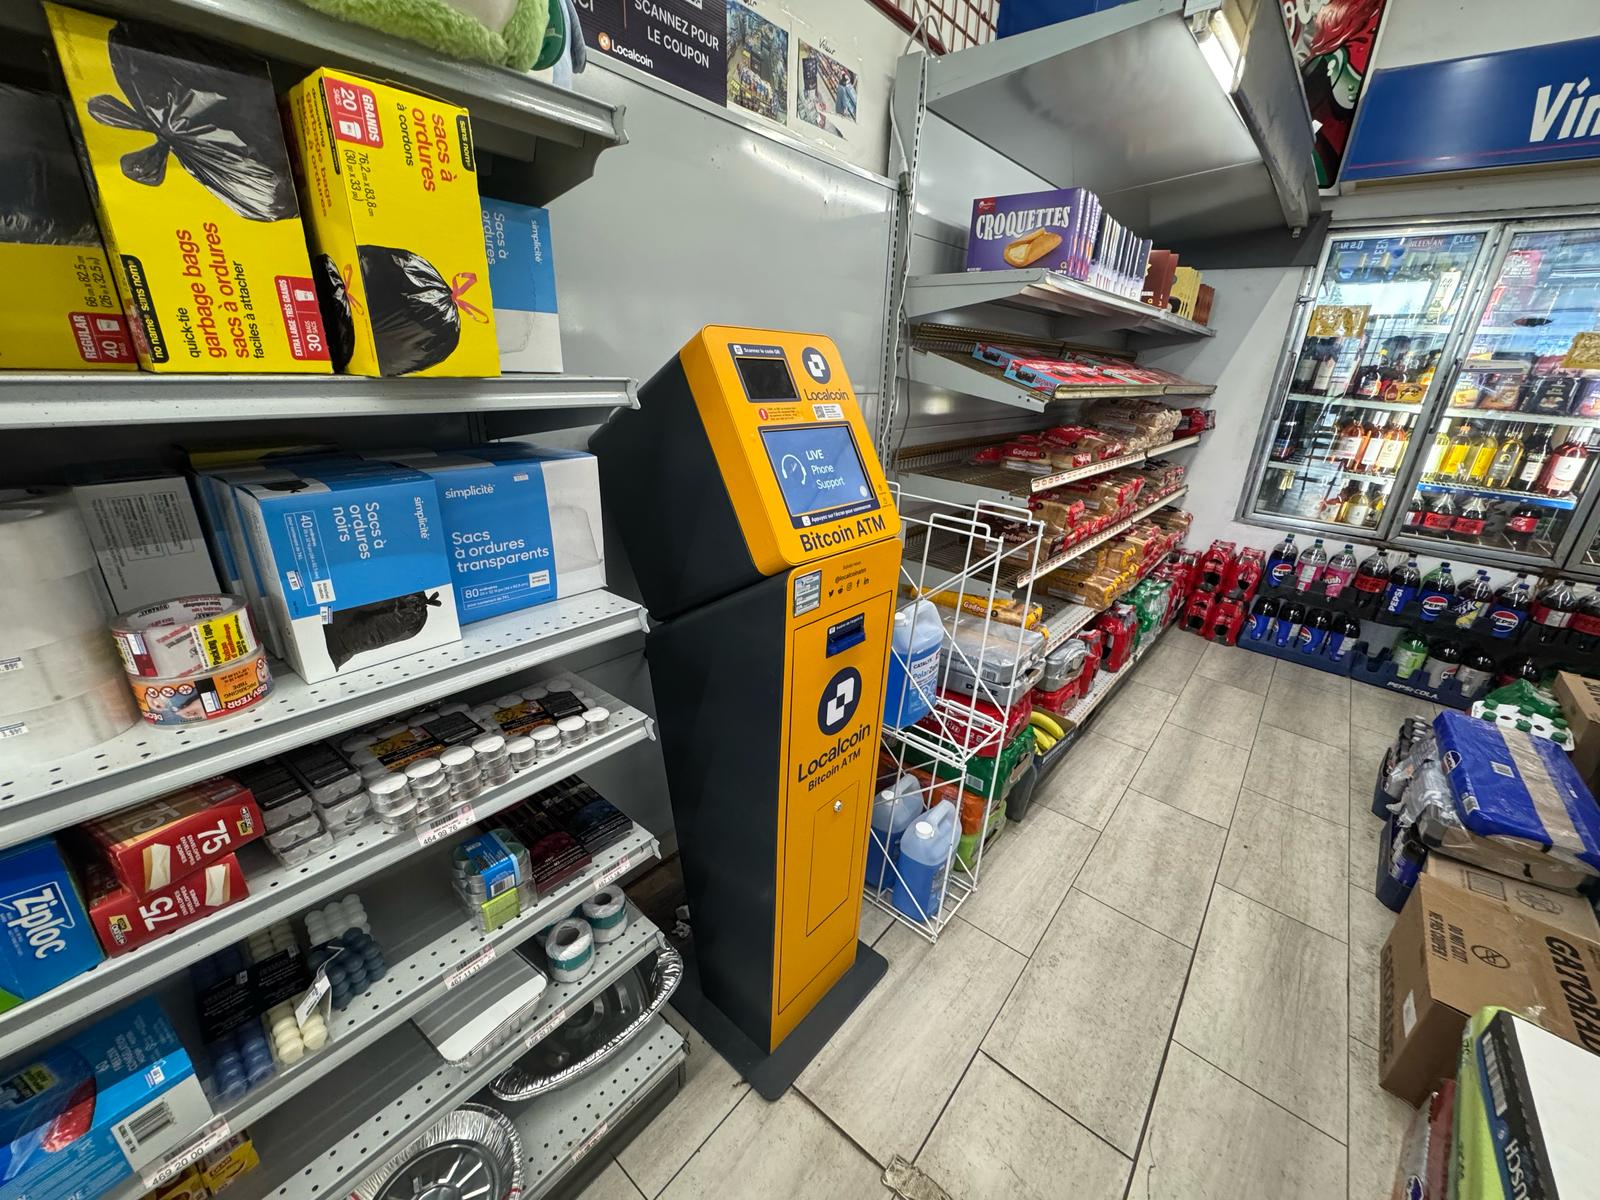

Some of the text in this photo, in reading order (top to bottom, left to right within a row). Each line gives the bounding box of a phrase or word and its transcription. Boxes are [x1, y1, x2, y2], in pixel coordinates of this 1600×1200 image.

[634, 0, 719, 52] SCANNEZ POUR
[611, 38, 654, 69] Localcoin
[647, 26, 709, 69] LE COUPON
[333, 88, 343, 106] SACS
[340, 87, 358, 112] 20
[305, 91, 323, 163] garbage
[362, 93, 381, 143] GRANDS
[396, 102, 414, 166] à cordons
[411, 107, 436, 192] ordures
[431, 112, 457, 182] sacs à
[482, 209, 496, 265] ordures
[494, 211, 510, 260] Sacs à
[975, 205, 1073, 241] CROQUETTES
[137, 288, 150, 311] sans
[176, 229, 228, 359] garbage bags
[203, 222, 249, 359] sacs à ordures
[233, 260, 253, 311] attacher
[72, 315, 98, 360] REGULAR
[102, 340, 119, 358] 40
[177, 307, 201, 359] quick-tie
[249, 323, 264, 359] faciles
[306, 334, 322, 352] 30
[803, 388, 850, 402] Localcoin
[805, 449, 825, 461] LIVE
[810, 464, 835, 475] Phone
[444, 483, 496, 501] simplicité
[815, 476, 846, 491] Support
[300, 514, 314, 529] 40
[331, 506, 351, 544] noirs
[348, 504, 371, 560] ordures
[363, 501, 385, 550] Sacs à
[412, 495, 430, 540] simplicité
[799, 514, 887, 553] Bitcoin ATM
[450, 529, 491, 547] Sacs
[453, 539, 526, 560] à ordures
[455, 546, 550, 575] transparents
[465, 588, 480, 599] 80
[1388, 588, 1404, 613] PEPSI
[1492, 616, 1519, 629] PEPSI
[227, 693, 253, 709] TEAR
[796, 722, 872, 783] Localcoin
[807, 749, 862, 793] Bitcoin ATM
[179, 836, 196, 866] ENVELOPPES
[187, 833, 202, 861] ENVELOPES
[196, 818, 232, 856] 75
[138, 895, 179, 932] 75
[174, 889, 188, 917] ENVELOPES
[11, 885, 68, 961] Ziploc
[152, 1147, 204, 1186] 469 20 00
